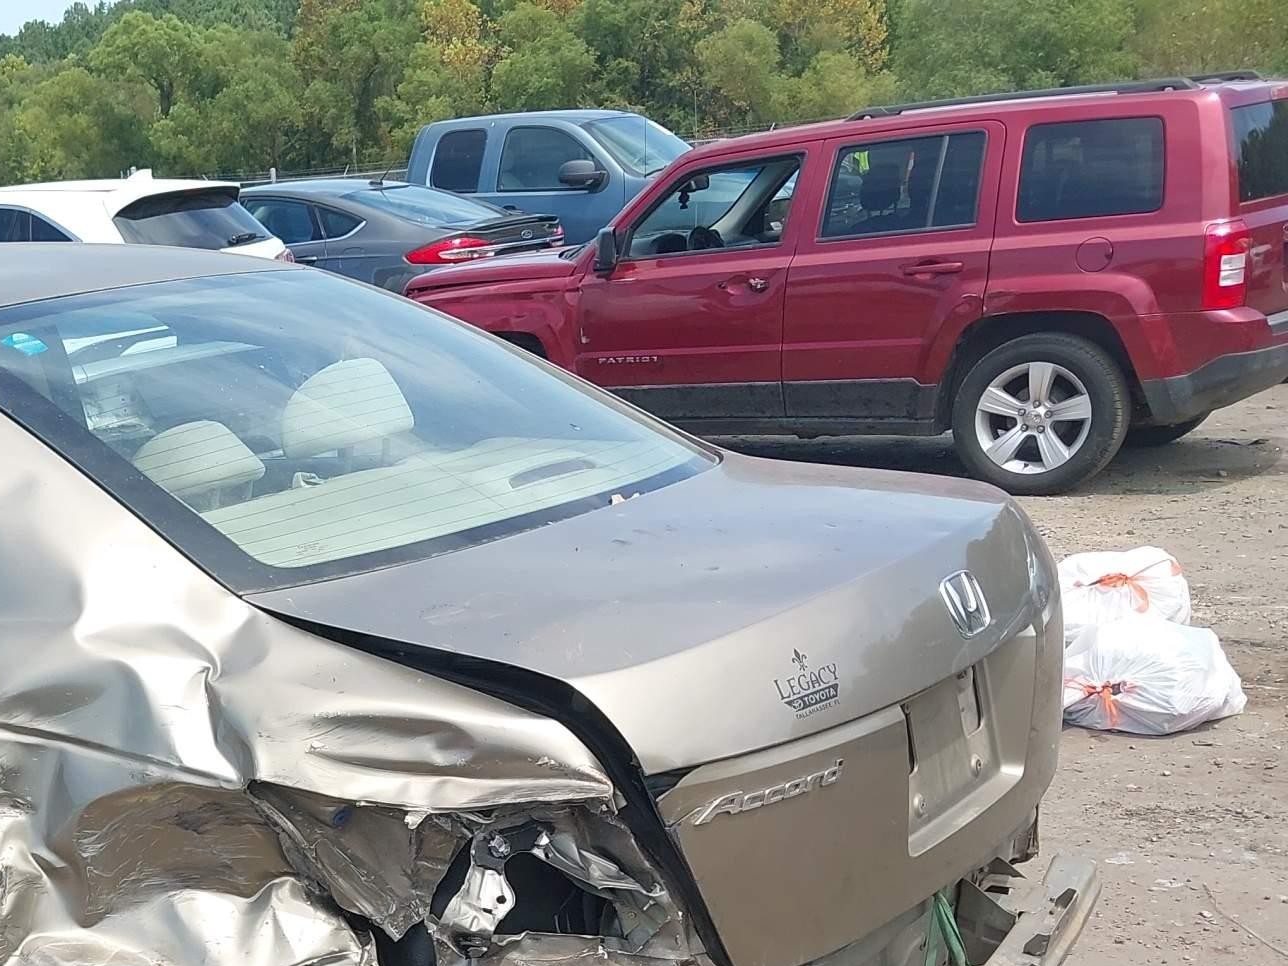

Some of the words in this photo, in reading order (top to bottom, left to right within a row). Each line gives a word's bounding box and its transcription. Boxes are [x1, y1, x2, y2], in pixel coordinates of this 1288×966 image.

[598, 356, 658, 365] PATRIOT
[774, 663, 838, 700] LEGACY
[803, 687, 837, 705] TOYOTA
[690, 758, 844, 826] Accord
